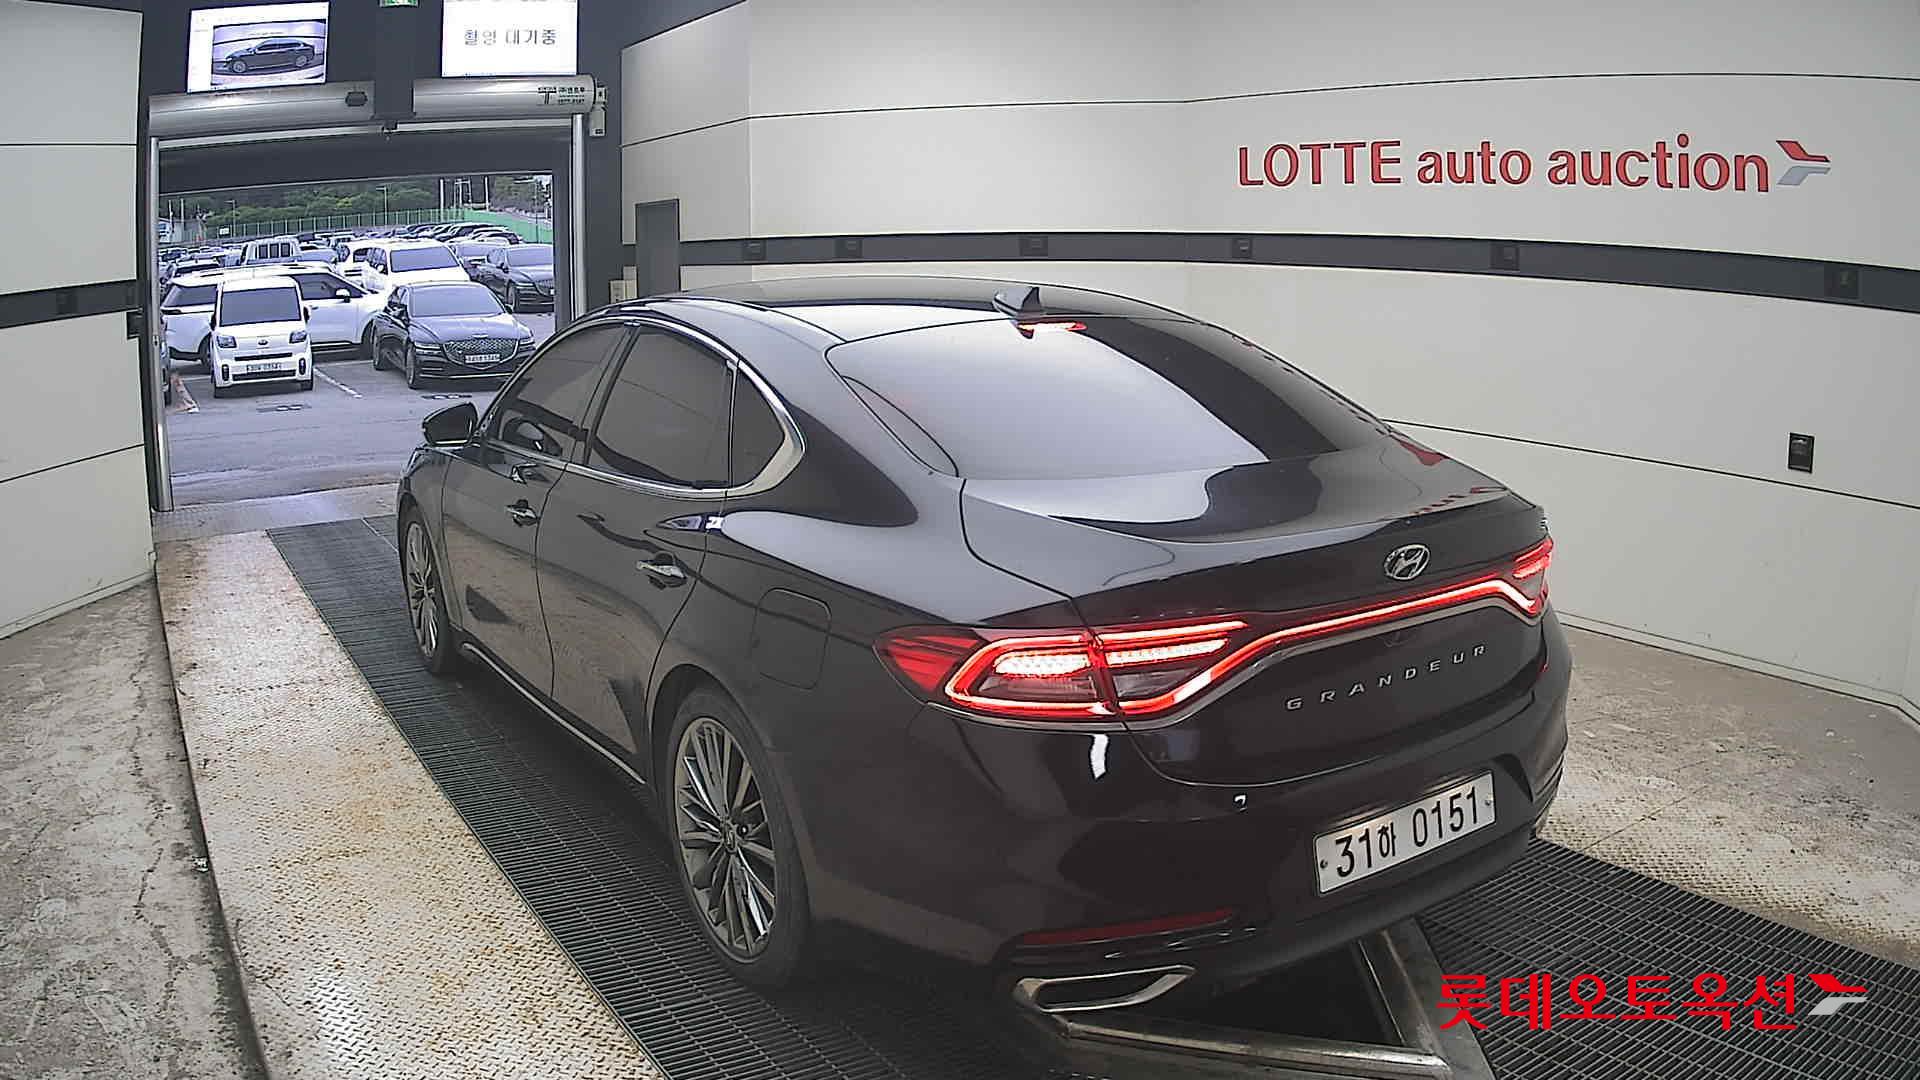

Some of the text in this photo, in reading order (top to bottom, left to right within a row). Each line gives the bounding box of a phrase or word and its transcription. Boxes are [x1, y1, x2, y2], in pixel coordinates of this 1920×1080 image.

[504, 28, 557, 46] 대기중
[1239, 133, 1769, 193] LOTTE auto auction
[1286, 644, 1486, 711] GRANDEUR
[1335, 786, 1478, 878] 31하 0151
